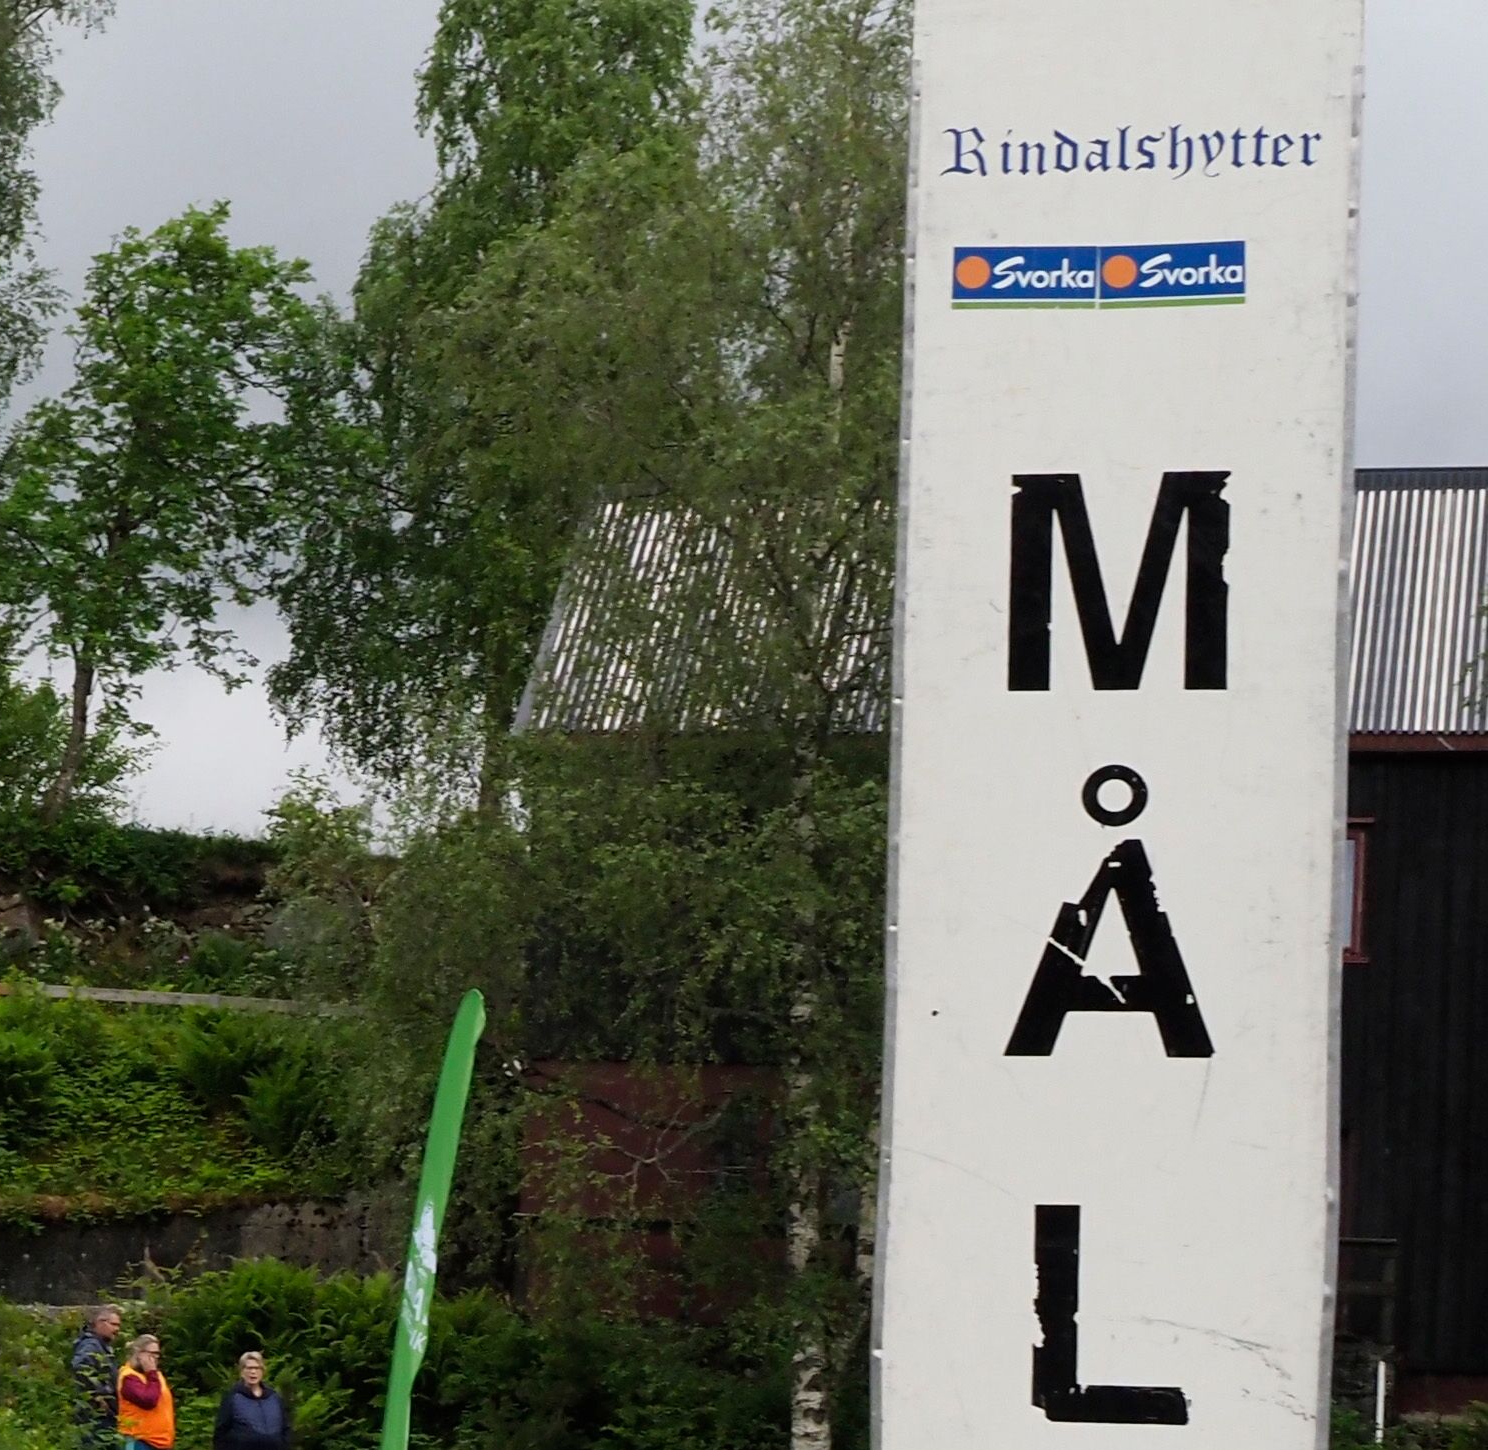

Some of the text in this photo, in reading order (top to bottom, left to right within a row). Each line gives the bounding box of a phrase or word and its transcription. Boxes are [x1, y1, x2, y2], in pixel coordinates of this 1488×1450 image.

[940, 125, 1323, 179] Rindalshytter
[991, 253, 1244, 290] Svorka Svorka
